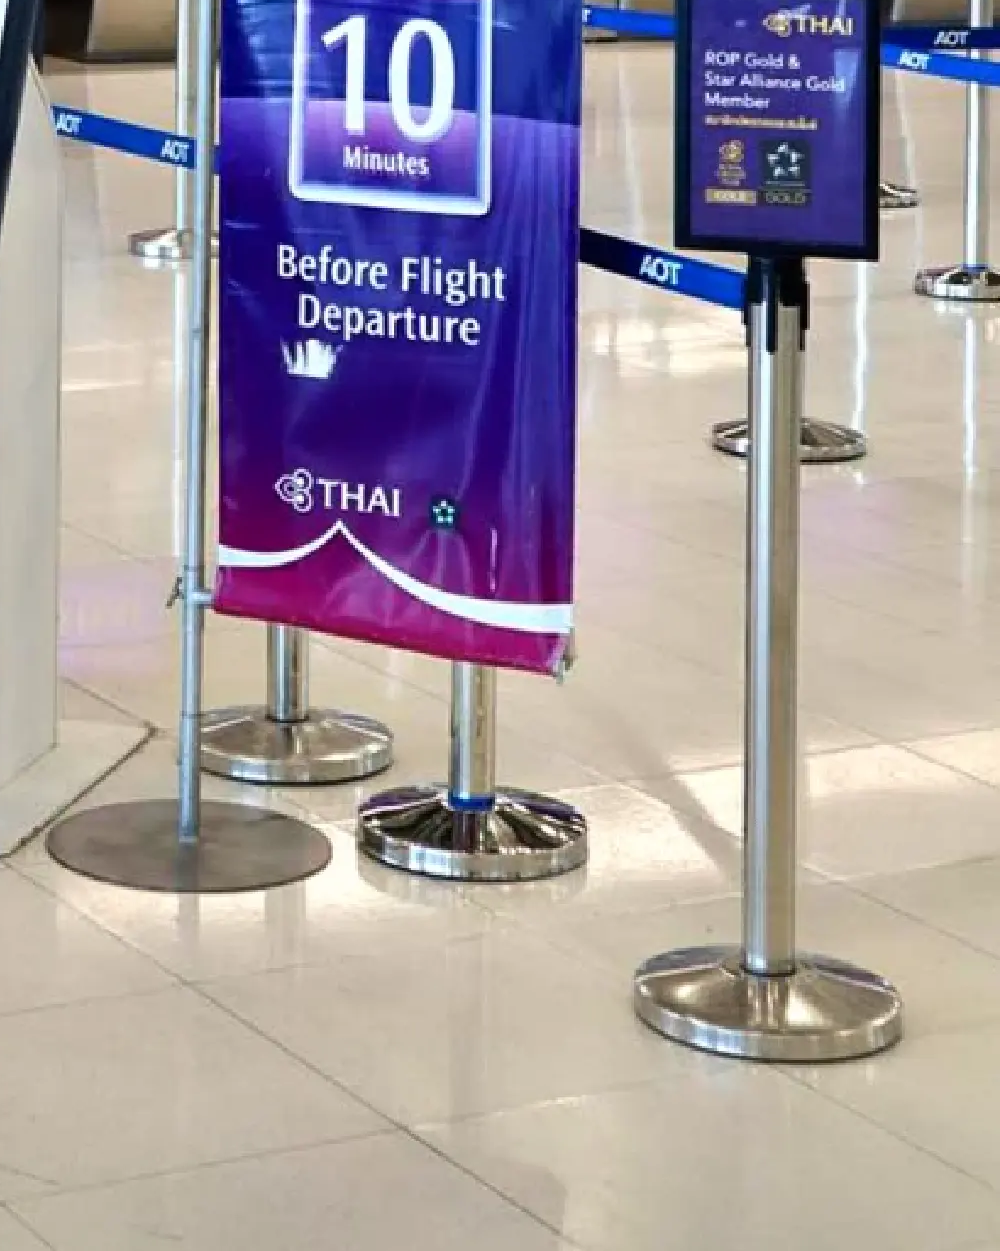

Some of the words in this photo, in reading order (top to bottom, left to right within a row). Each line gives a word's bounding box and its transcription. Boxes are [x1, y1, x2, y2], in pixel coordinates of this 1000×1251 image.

[797, 14, 854, 36] THAI
[933, 31, 969, 46] AOT
[704, 49, 740, 67] ROP
[743, 53, 784, 69] Gold
[788, 54, 801, 70] &
[899, 52, 930, 70] AOT
[320, 14, 455, 142] 10
[704, 71, 735, 87] Star
[740, 73, 802, 91] Alliance
[805, 76, 847, 92] Gold
[704, 93, 771, 109] Member
[56, 112, 82, 136] AOT
[160, 139, 190, 163] AOT
[342, 146, 430, 176] Minutes
[277, 243, 389, 289] Before
[401, 255, 507, 306] Flight
[639, 254, 683, 285] AOT
[298, 293, 482, 346] Departure
[316, 477, 400, 517] THAI
